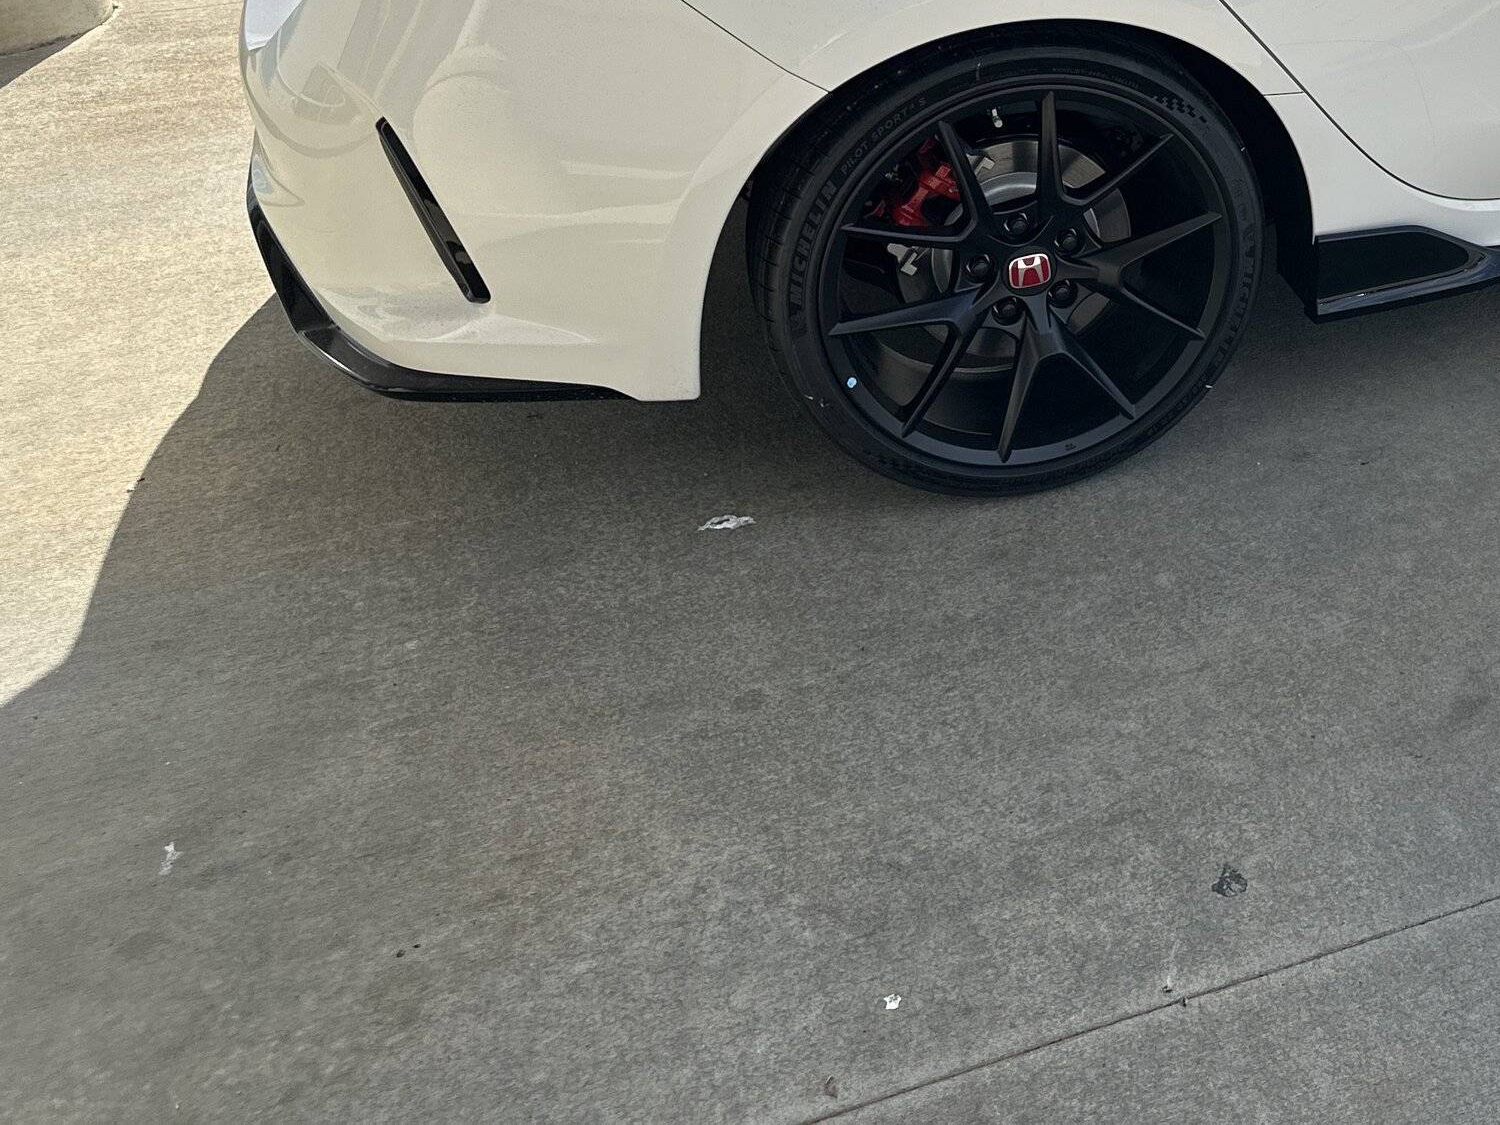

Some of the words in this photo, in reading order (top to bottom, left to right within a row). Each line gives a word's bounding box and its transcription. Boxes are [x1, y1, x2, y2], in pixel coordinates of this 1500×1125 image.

[840, 141, 868, 175] PILOT
[871, 108, 909, 140] SPORT
[789, 178, 838, 306] MICHELIN
